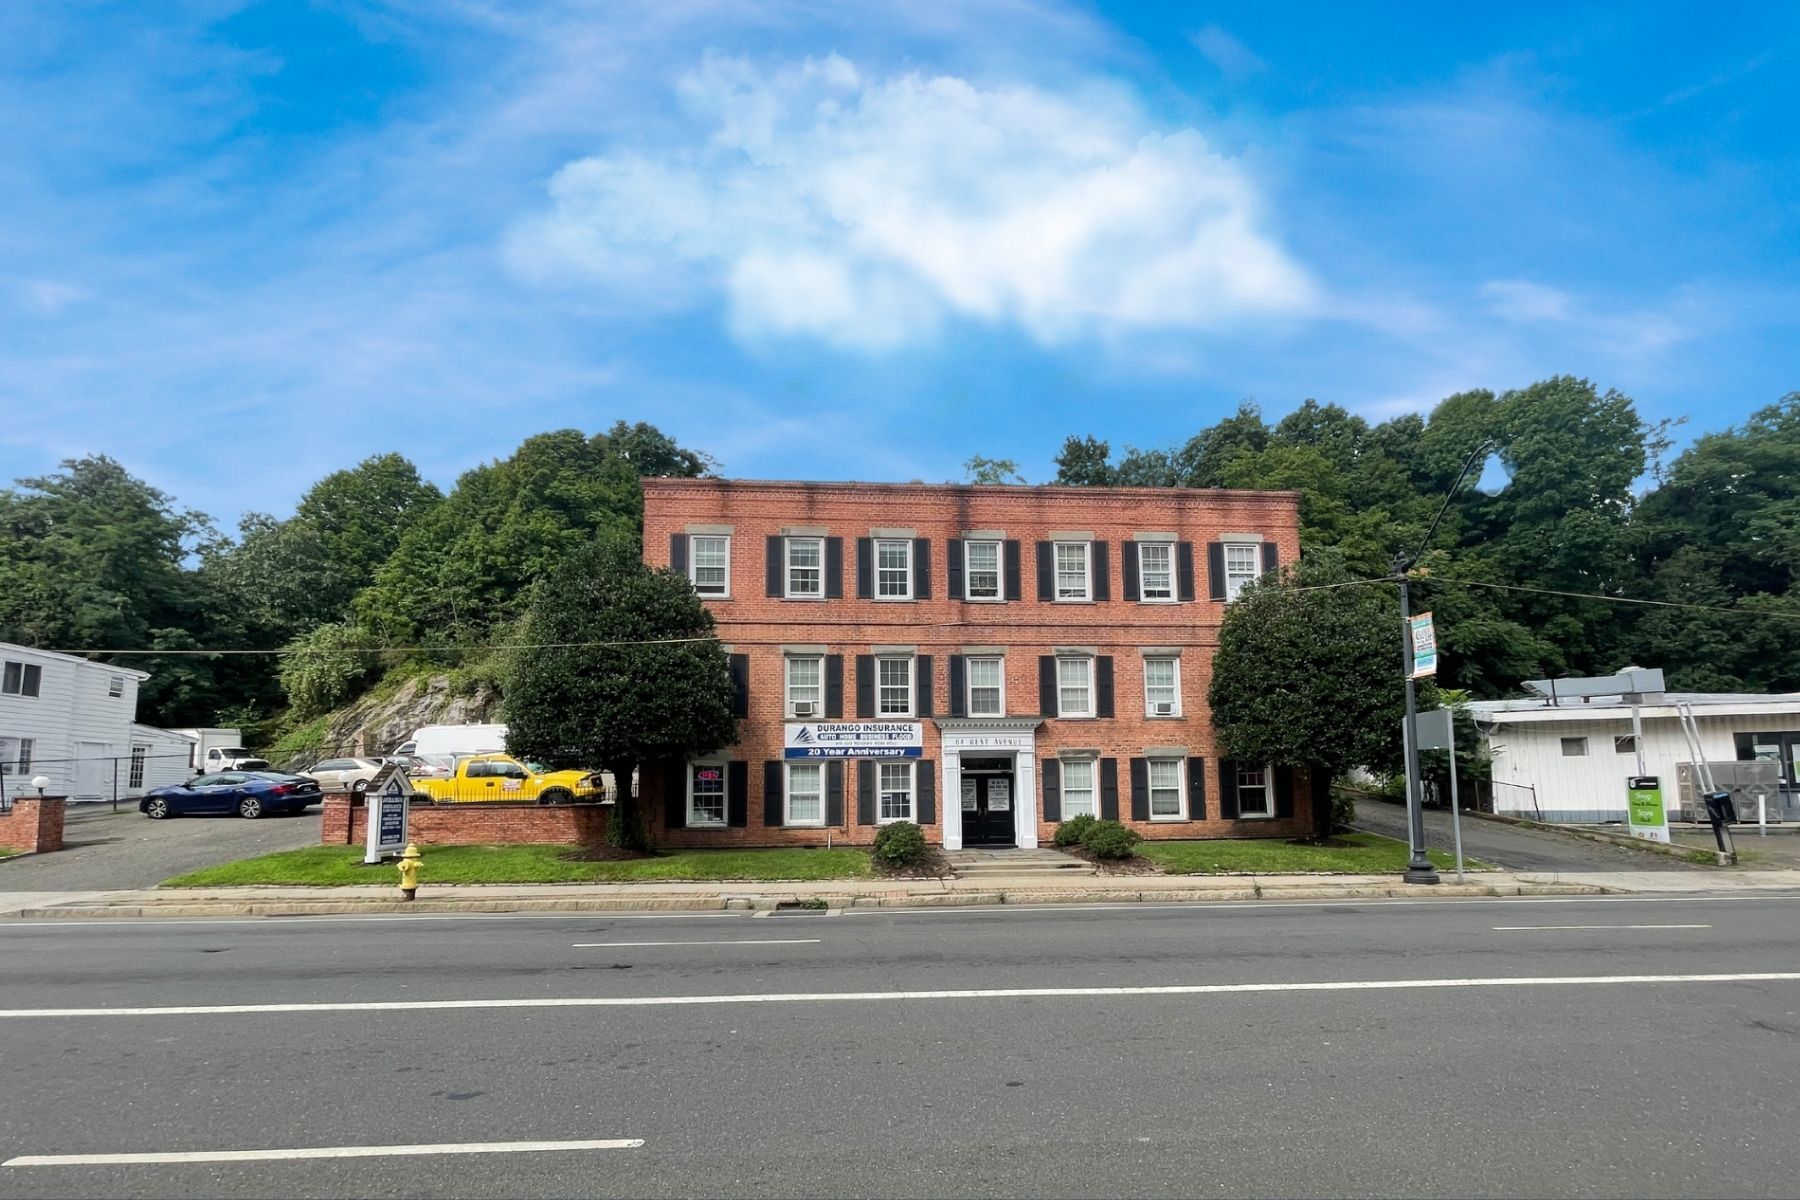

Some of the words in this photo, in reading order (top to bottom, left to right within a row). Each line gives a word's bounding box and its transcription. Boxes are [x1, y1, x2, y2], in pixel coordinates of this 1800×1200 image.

[817, 724, 861, 732] DURANGO
[863, 724, 914, 732] INSURANCE
[808, 748, 820, 756] 20
[823, 748, 845, 756] Year
[847, 748, 905, 757] Anniversary
